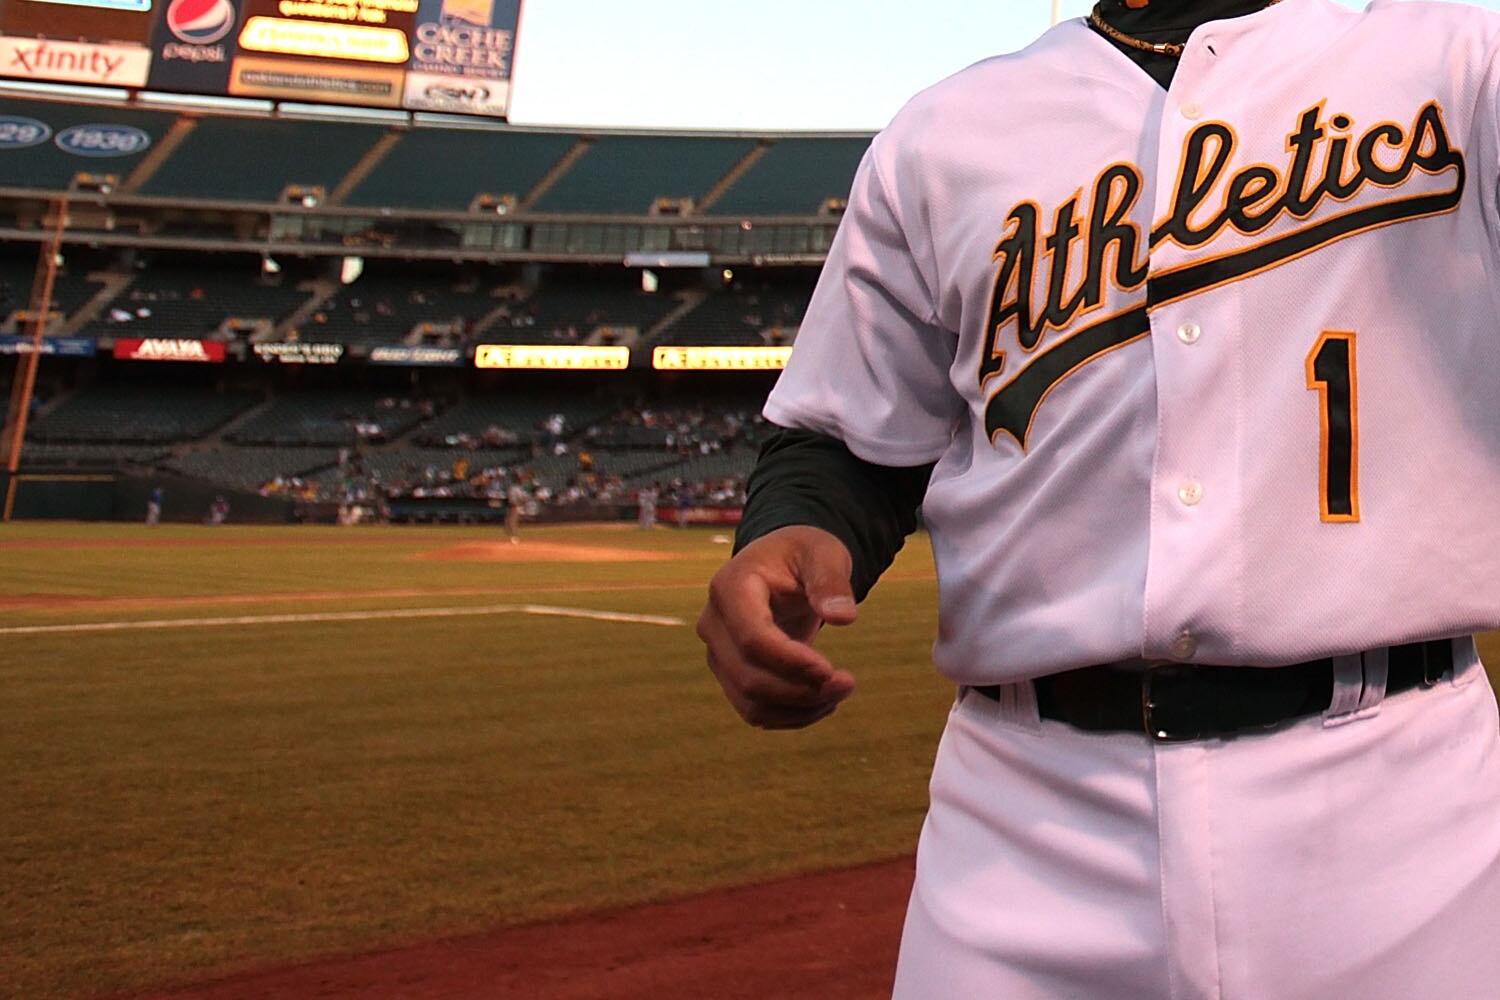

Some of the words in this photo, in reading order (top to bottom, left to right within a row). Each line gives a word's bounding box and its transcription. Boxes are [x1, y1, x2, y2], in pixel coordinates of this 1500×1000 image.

[161, 42, 225, 63] pepsi
[416, 22, 514, 54] CACHE
[10, 43, 126, 80] xfinity
[413, 42, 510, 70] CREEK
[978, 98, 1466, 388] Athletics
[137, 338, 208, 358] AVAYA
[1305, 331, 1359, 523] 1
